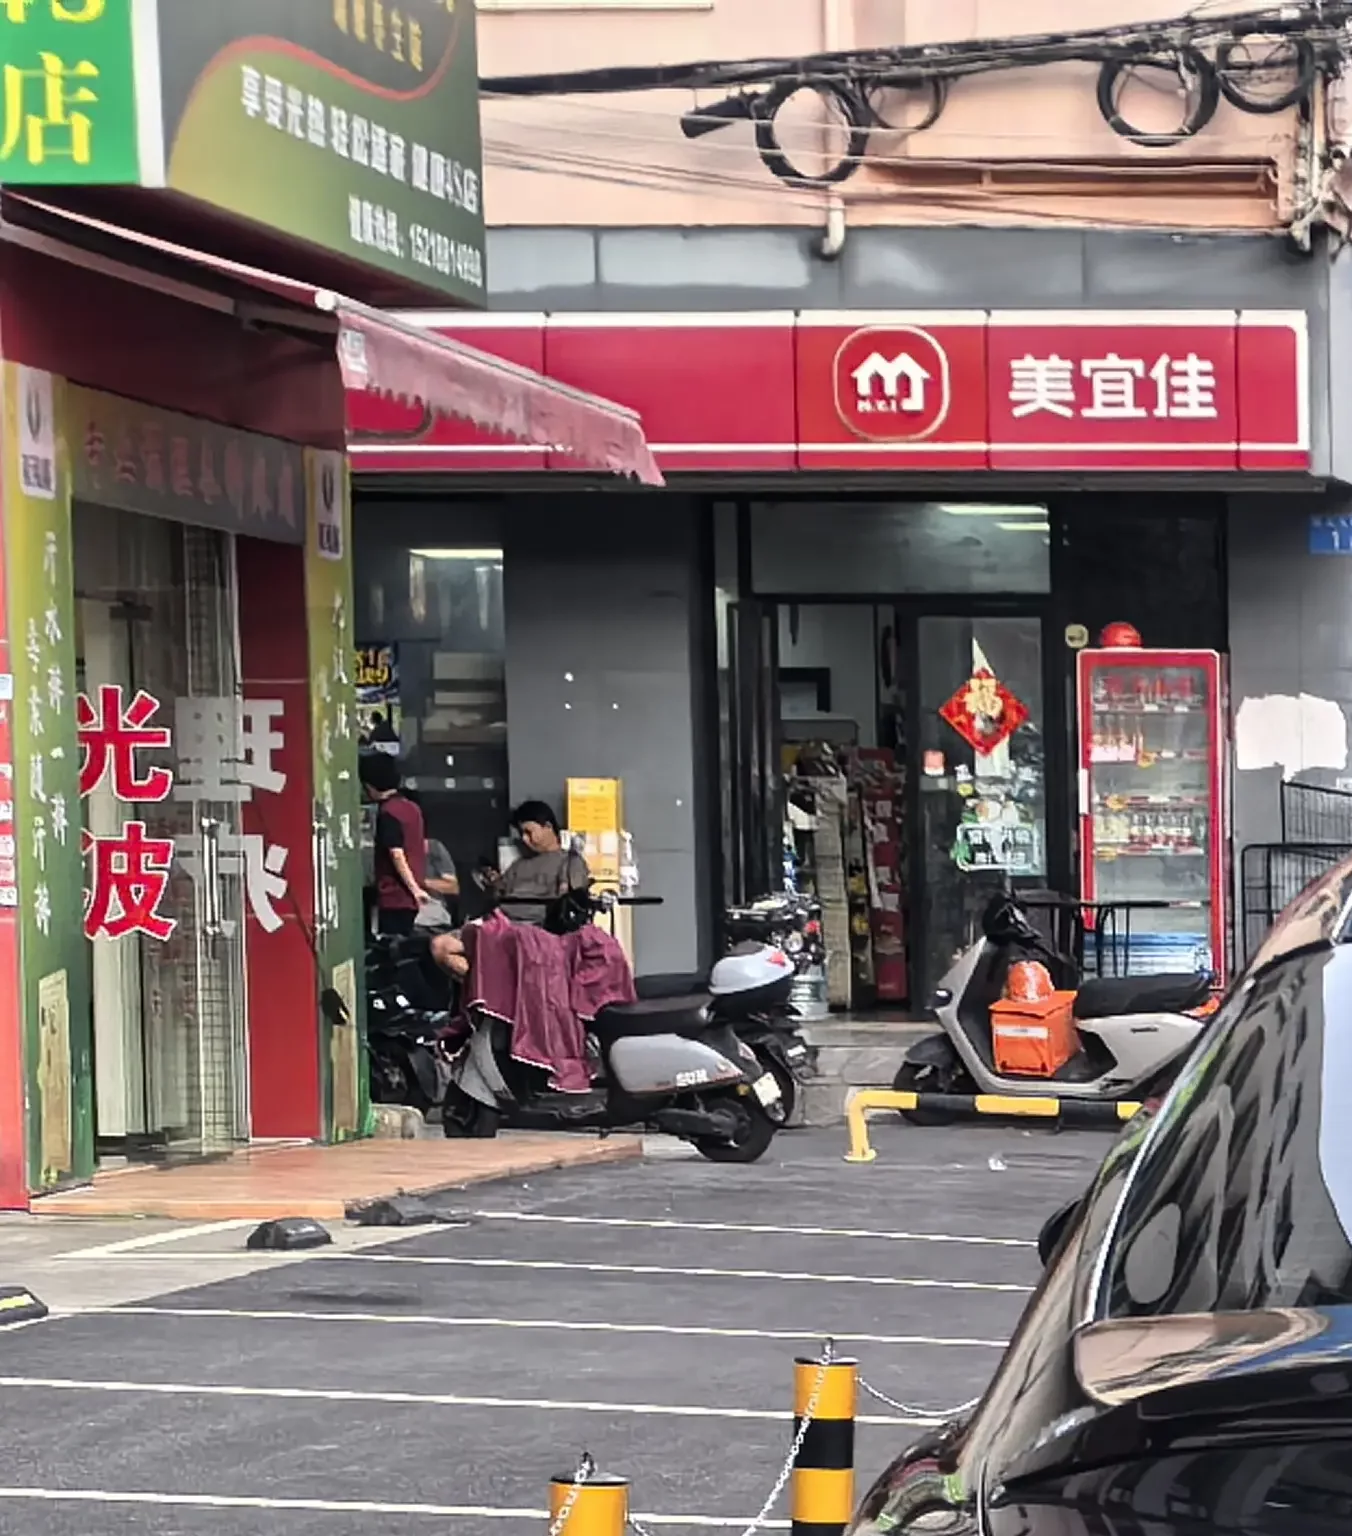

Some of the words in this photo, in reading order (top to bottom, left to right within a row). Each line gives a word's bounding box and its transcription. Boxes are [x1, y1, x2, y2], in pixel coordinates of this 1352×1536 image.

[1, 48, 98, 165] 店
[1008, 352, 1218, 419] 美宜佳
